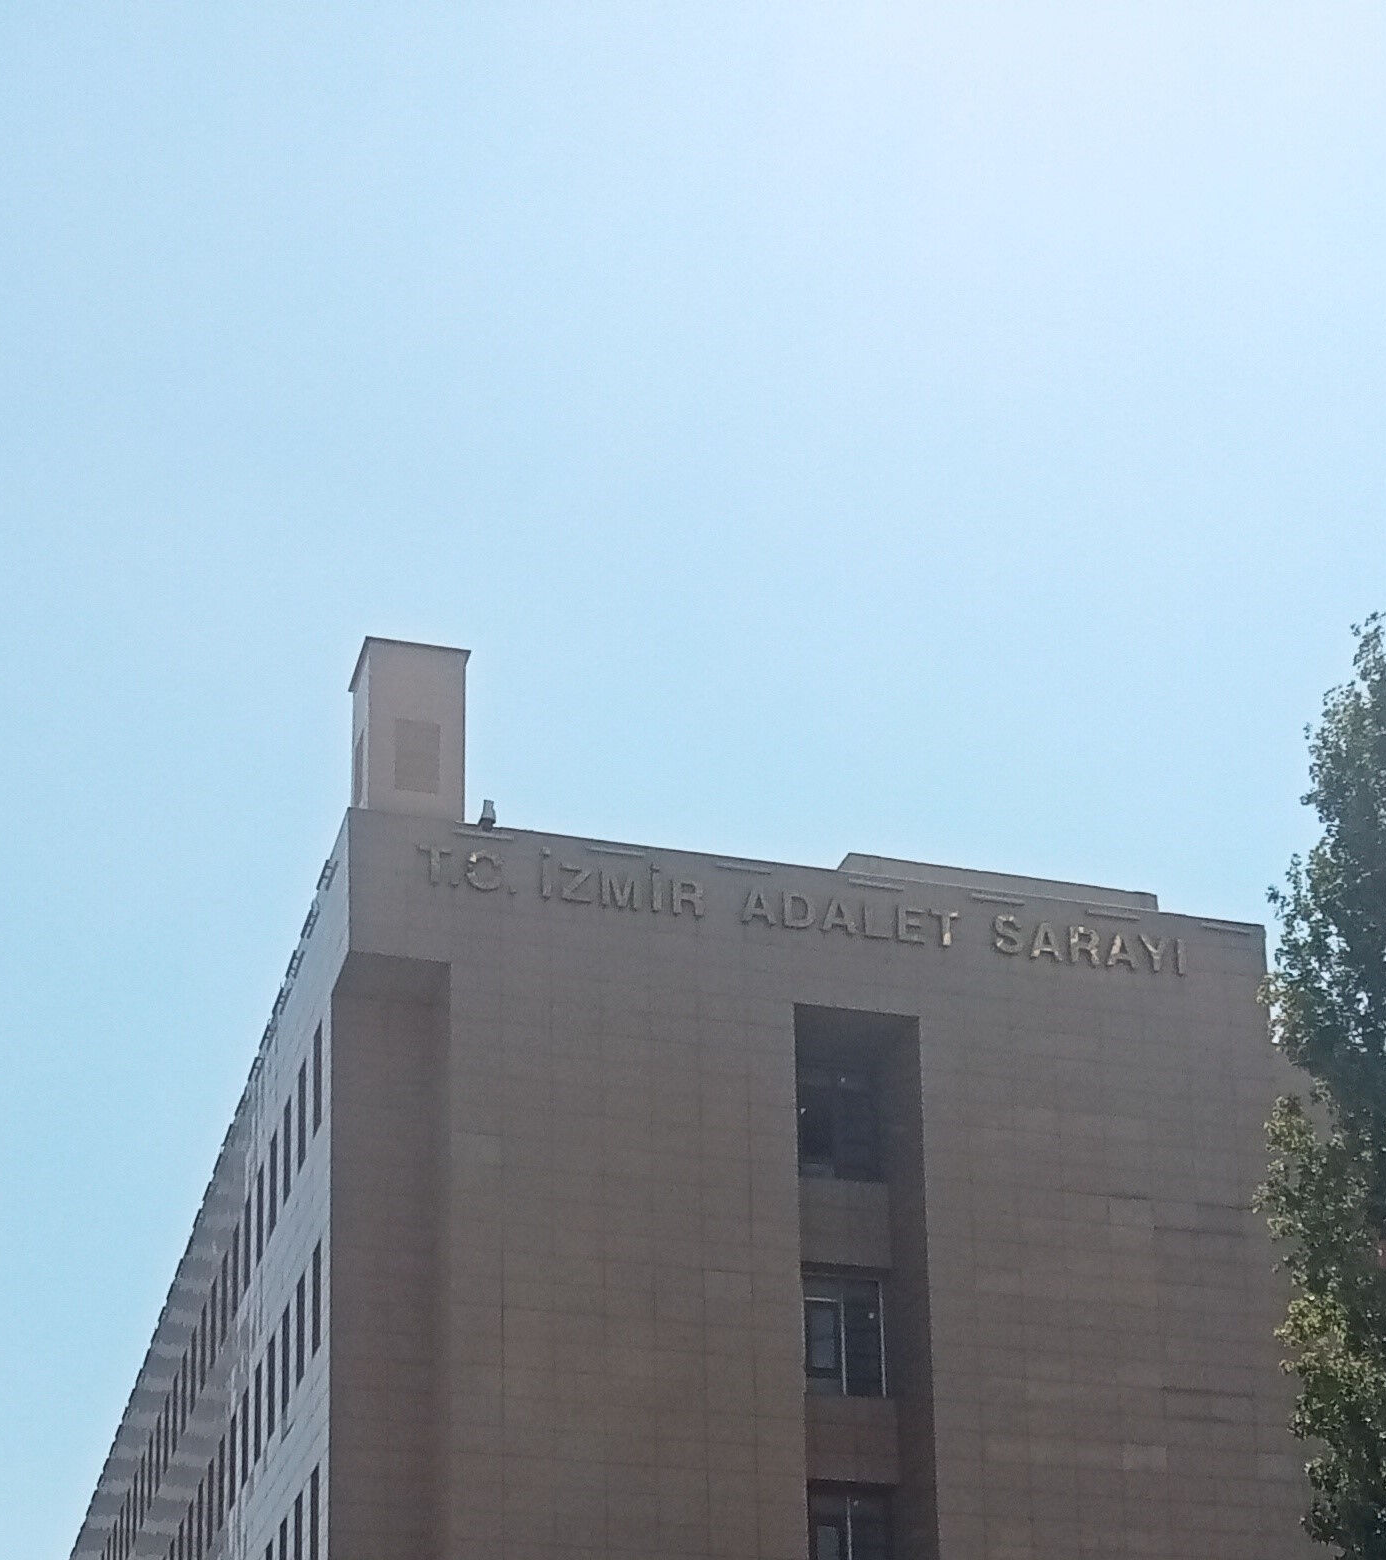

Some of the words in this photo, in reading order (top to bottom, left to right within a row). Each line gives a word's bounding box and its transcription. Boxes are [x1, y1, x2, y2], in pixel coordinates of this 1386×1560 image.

[539, 846, 706, 920] İZMİR
[741, 886, 961, 948] ADALET
[992, 912, 1187, 977] SARAYI
